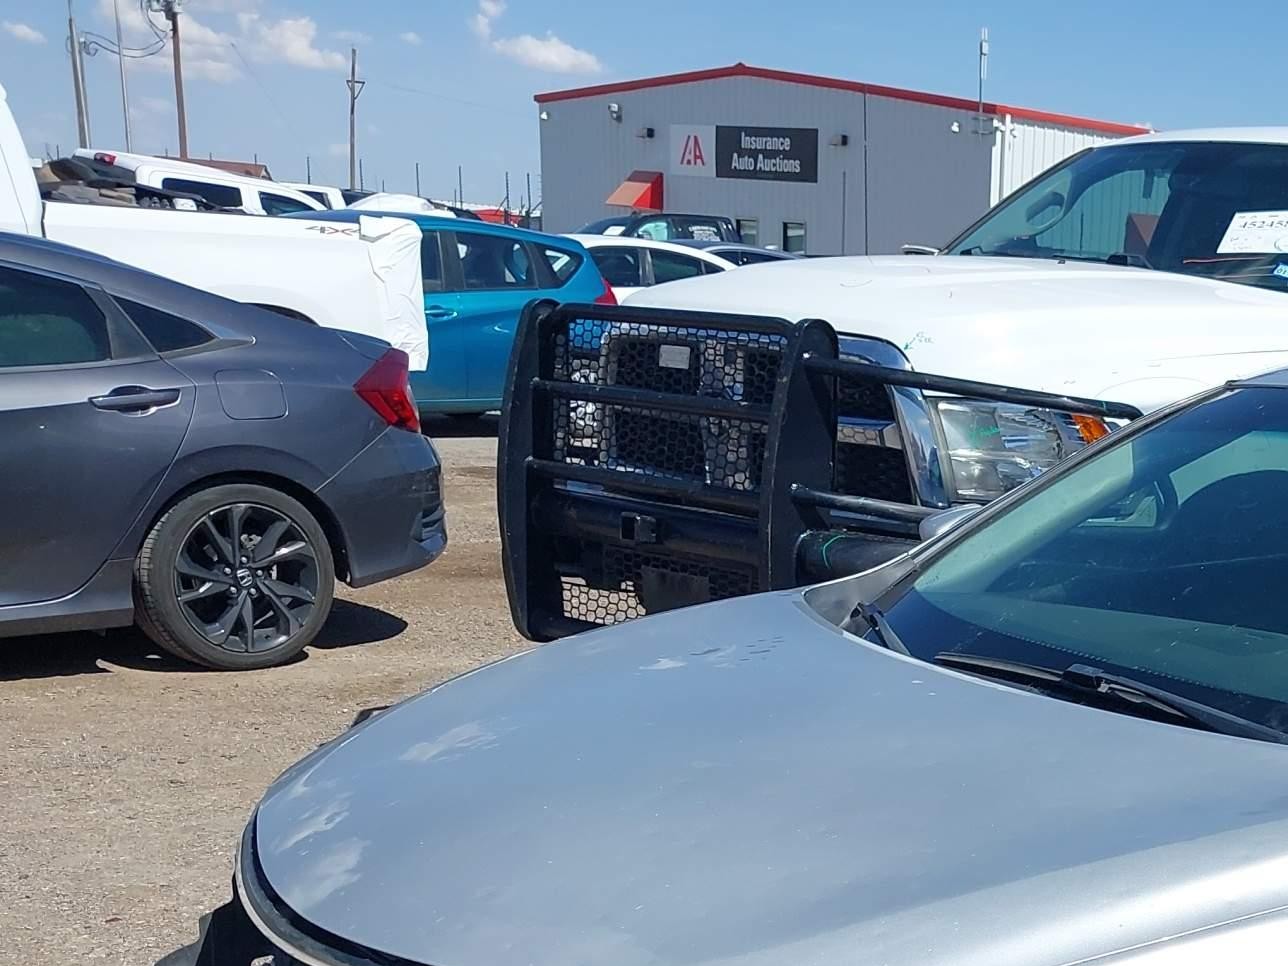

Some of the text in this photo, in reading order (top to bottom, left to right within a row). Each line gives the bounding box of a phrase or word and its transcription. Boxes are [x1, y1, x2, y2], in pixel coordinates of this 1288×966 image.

[741, 132, 790, 150] Insurance
[731, 152, 801, 173] Auto Auctions
